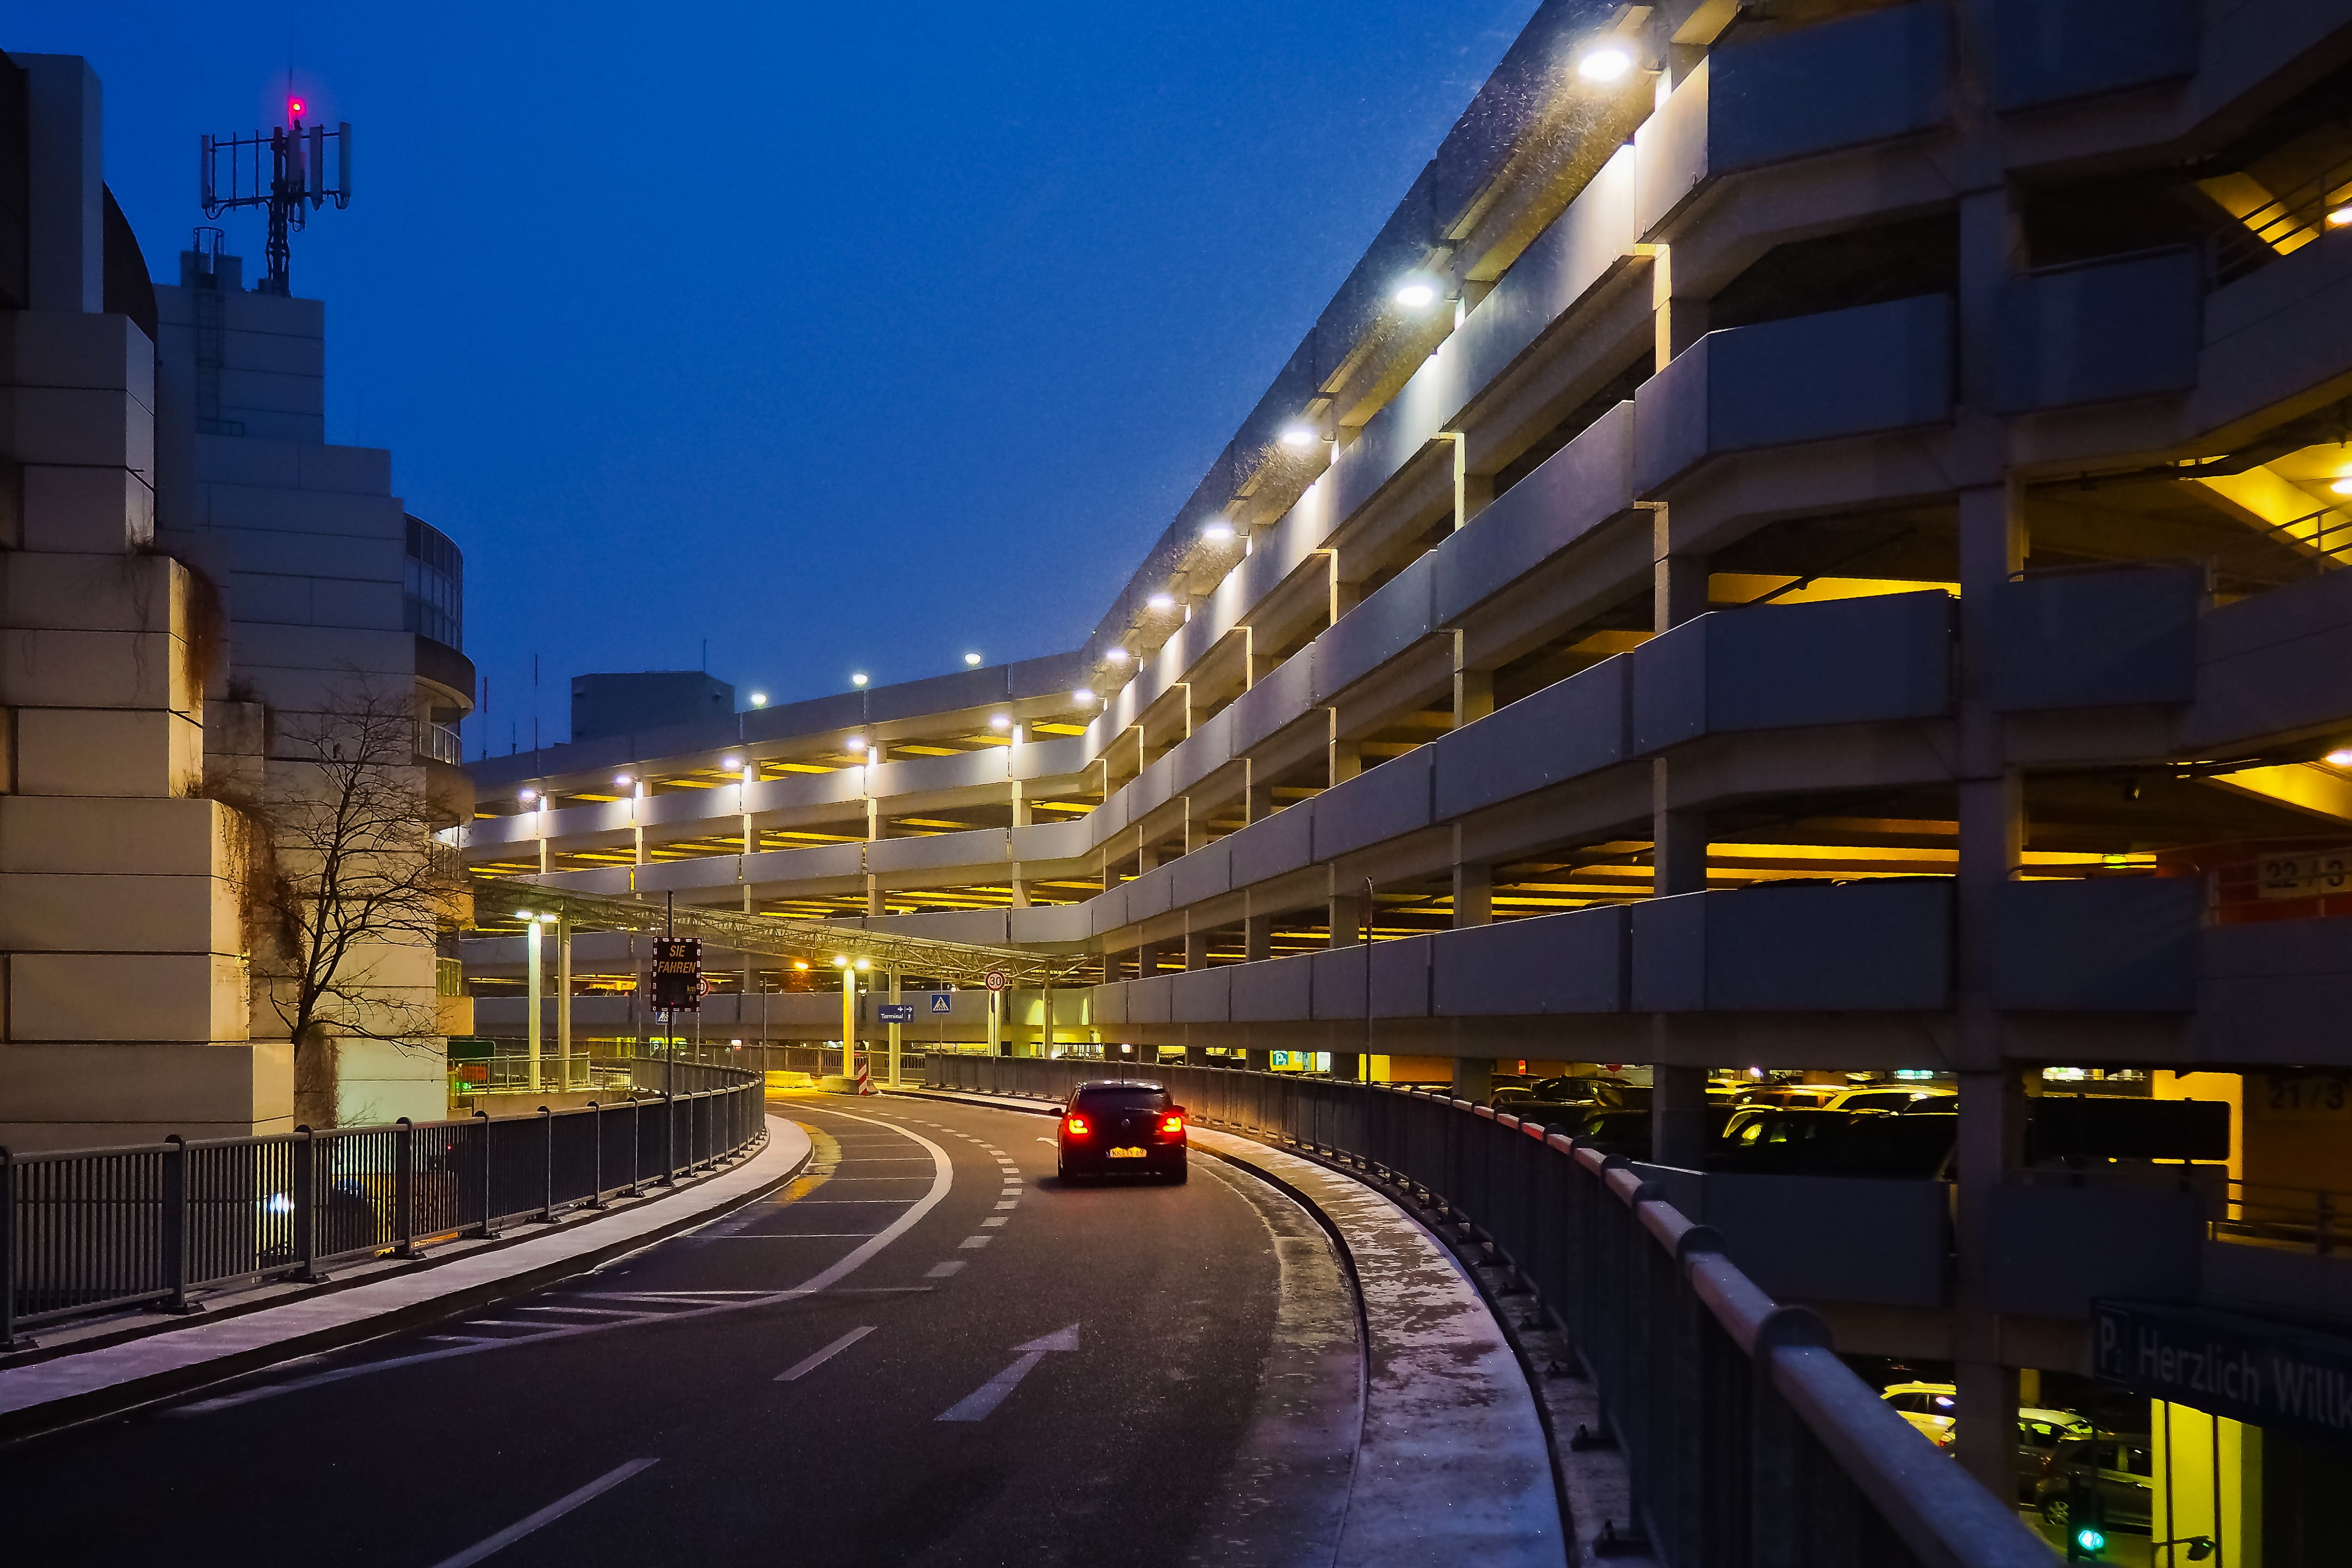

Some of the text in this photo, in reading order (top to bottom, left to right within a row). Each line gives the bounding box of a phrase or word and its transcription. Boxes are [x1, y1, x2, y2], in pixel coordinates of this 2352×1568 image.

[669, 944, 686, 957] SIE
[658, 961, 696, 974] FAHREN
[988, 976, 1001, 986] 30
[2138, 1324, 2260, 1407] Herzlich
